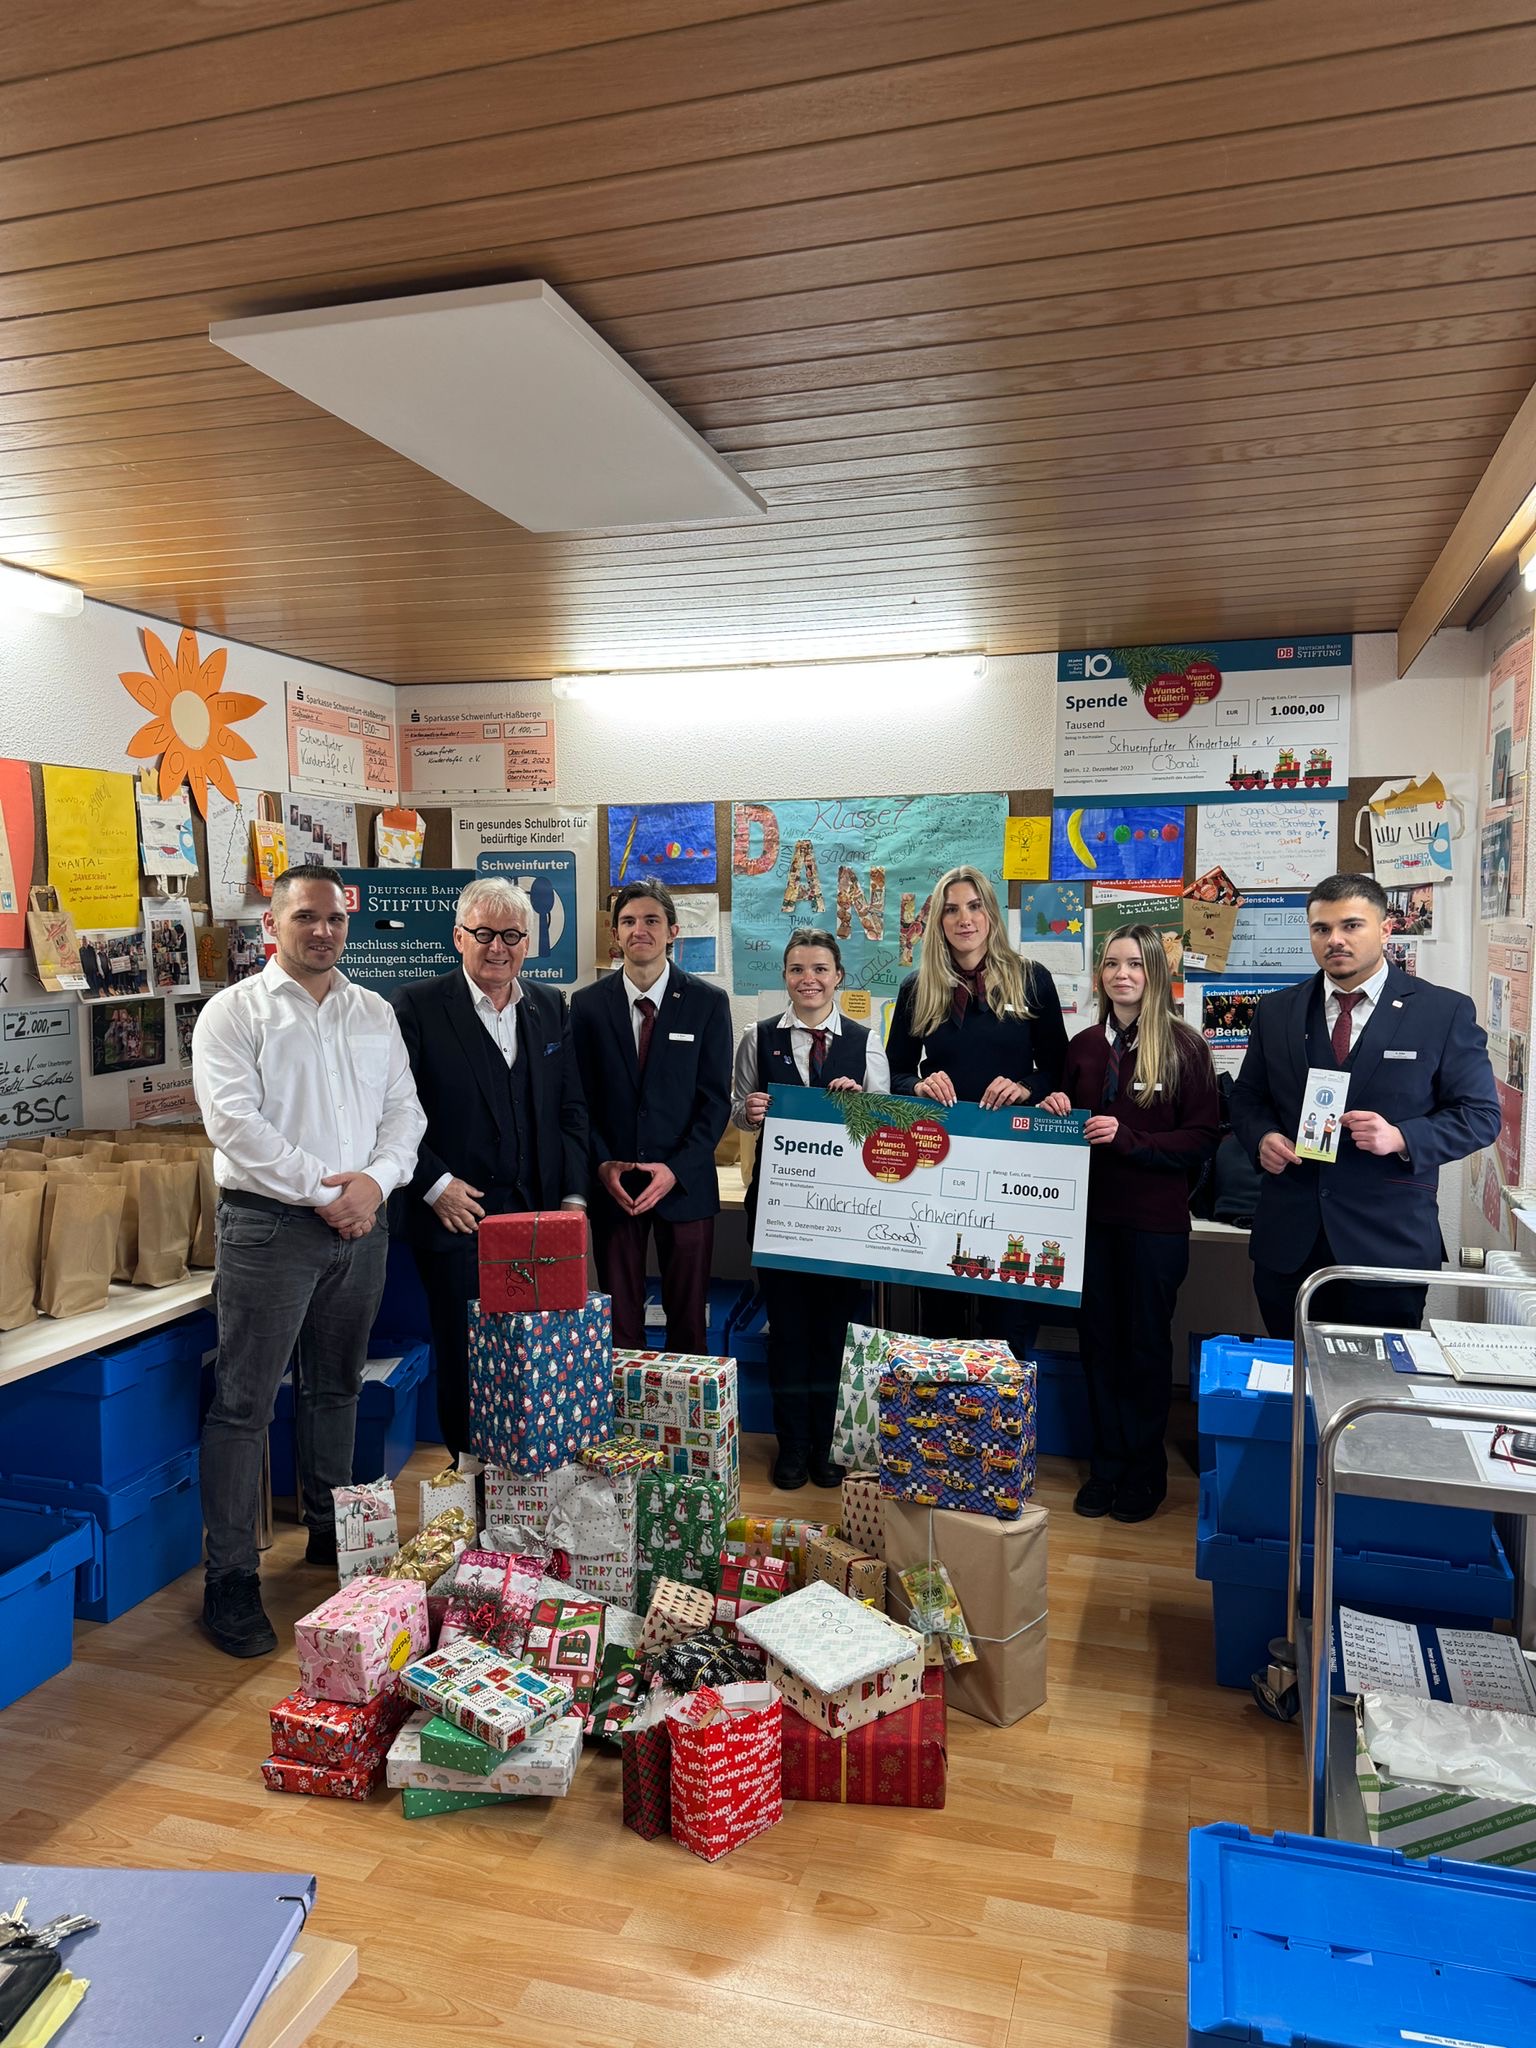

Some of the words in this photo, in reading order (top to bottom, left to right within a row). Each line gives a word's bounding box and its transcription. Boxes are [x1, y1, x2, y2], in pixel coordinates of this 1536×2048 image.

[1277, 647, 1293, 659] DB
[1297, 649, 1342, 659] STIFTUNG
[1185, 673, 1215, 681] Wunsch
[1152, 686, 1186, 695] Wunsch
[306, 694, 333, 709] Sparkasse
[1065, 693, 1128, 712] Spende
[1148, 694, 1189, 703] erfüllerin
[1270, 703, 1325, 716] 1.000,00
[424, 714, 460, 723] Sparkasse
[460, 710, 542, 722] Schweinfurt-Haßberge
[1065, 720, 1105, 730] Tausend
[1188, 733, 1242, 750] Kindertafel
[1063, 749, 1075, 757] an
[428, 755, 463, 766] Kindertafel
[808, 800, 892, 831] Klasse
[1205, 803, 1232, 819] Wir
[459, 819, 475, 830] Ein
[476, 818, 522, 832] gesundes
[524, 818, 571, 829] Schulbrot
[573, 817, 587, 828] für
[1220, 820, 1241, 829] tolle
[480, 833, 527, 846] bedürftige
[530, 832, 565, 844] Kinder!
[57, 856, 104, 870] CHANTAL
[481, 860, 570, 870] Schweinfurter
[775, 844, 793, 879] KIITOS
[368, 885, 428, 895] DEUTSCHE
[431, 885, 463, 895] BAHN
[1244, 896, 1285, 904] denscheck
[788, 914, 814, 927] THANK
[400, 940, 446, 950] sichern.
[338, 953, 407, 966] erbindungen
[409, 953, 460, 964] schaffen.
[347, 967, 396, 978] Weichen
[398, 967, 440, 978] stellen.
[518, 967, 563, 979] ertafel
[1206, 989, 1256, 997] Schweinfurter
[156, 1078, 193, 1092] Sparkasse
[13, 1094, 70, 1127] BSC
[1013, 1118, 1029, 1129] DB
[1034, 1117, 1063, 1125] DEUTSCHE
[1033, 1122, 1079, 1134] STIFTUNG
[910, 1131, 943, 1142] Wunsch
[773, 1134, 844, 1157] Spende
[876, 1139, 906, 1149] Wunsch
[915, 1140, 942, 1149] rfüller
[871, 1148, 909, 1158] erfüller:in
[771, 1163, 816, 1178] Tausend
[952, 1179, 966, 1187] EUR
[1000, 1182, 1060, 1200] 1.000,00
[767, 1196, 781, 1207] an
[805, 1190, 882, 1217] Kindertafel
[908, 1200, 996, 1229] Schweinfurt
[766, 1218, 786, 1228] Berlin,
[787, 1220, 794, 1228] 9.
[794, 1221, 825, 1232] Dezember
[825, 1225, 842, 1233] 2025
[490, 1513, 548, 1525] CHRISTMAS
[579, 1565, 612, 1577] MERRY
[922, 1586, 943, 1601] SOUR
[727, 1730, 769, 1743] HO-HO-HO!
[711, 1761, 757, 1785] HO-HO-HO!
[738, 1772, 775, 1791] HO-HO-HO!
[1390, 1813, 1403, 1823] Bon
[1424, 1801, 1442, 1812] Guten
[730, 1815, 768, 1833] HO-HO-HO!
[734, 1818, 773, 1849] HO-HO-HO!
[1420, 1840, 1433, 1850] Bon
[1454, 1829, 1472, 1840] Guten
[1472, 1822, 1493, 1834] Appetit
[1496, 1815, 1512, 1826] Buon
[1502, 1850, 1523, 1862] Appetit
